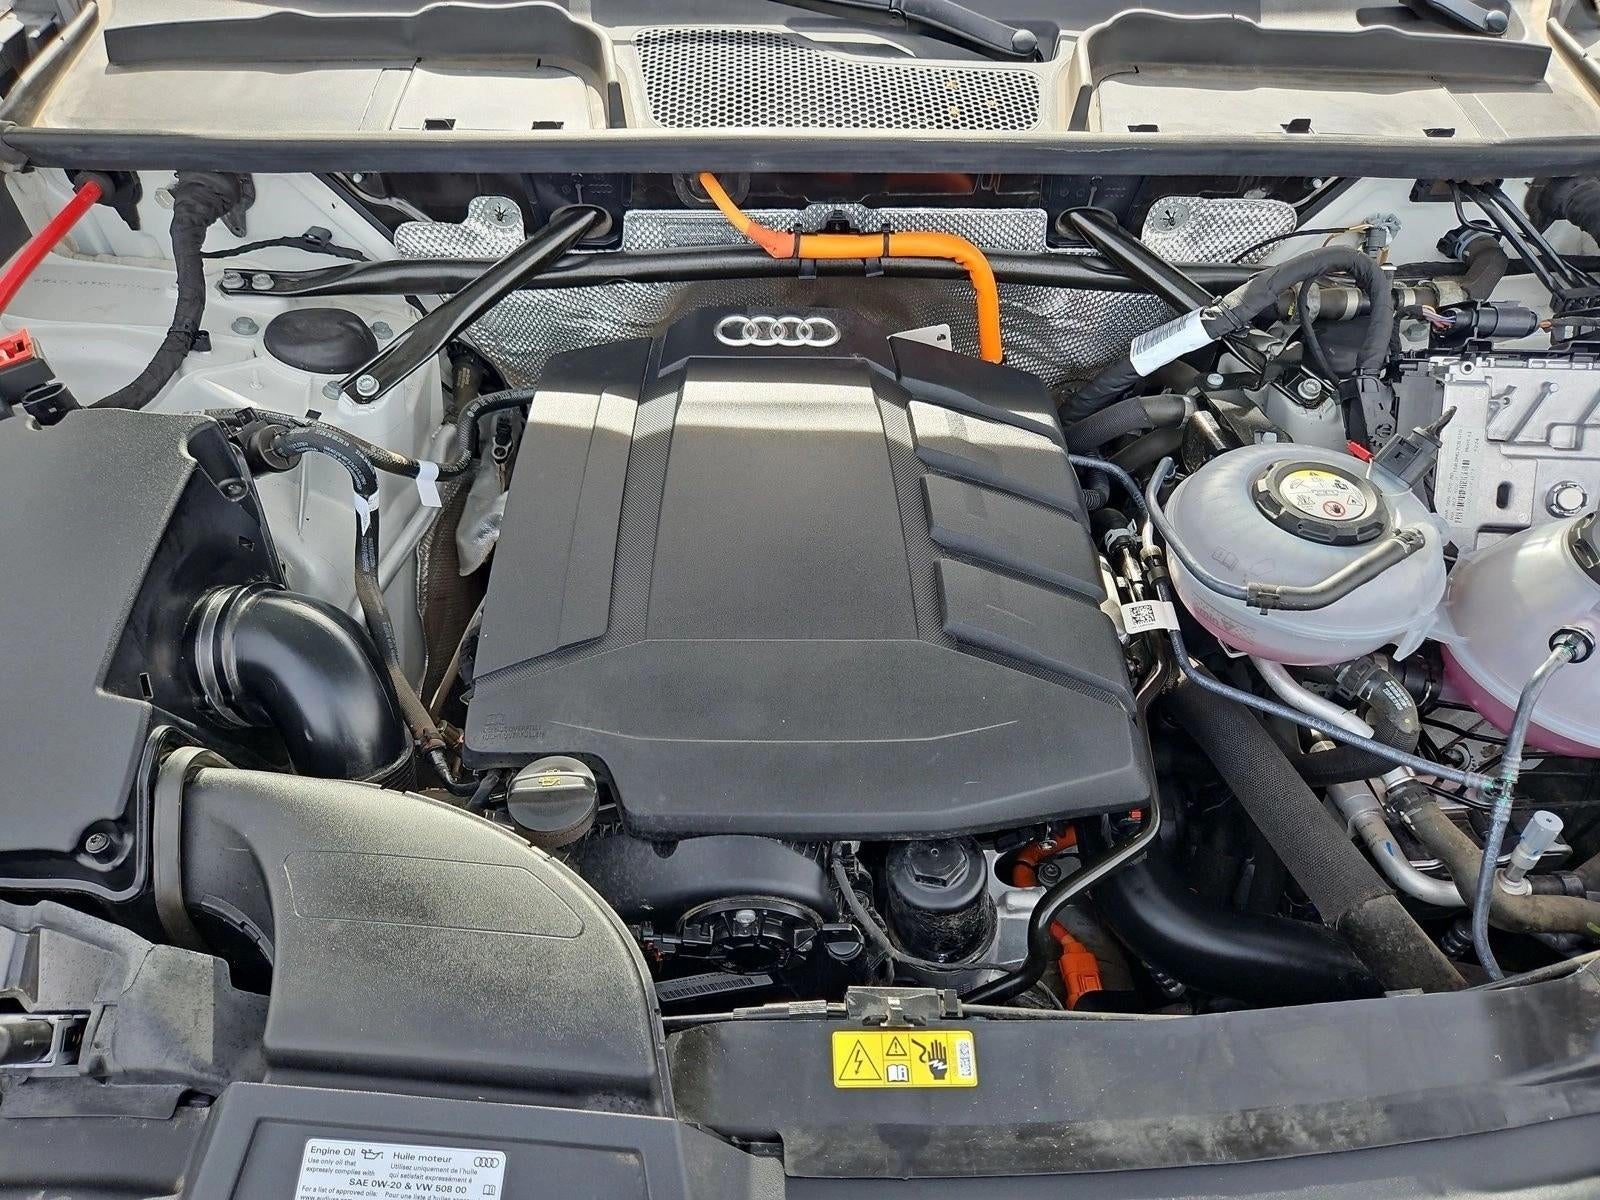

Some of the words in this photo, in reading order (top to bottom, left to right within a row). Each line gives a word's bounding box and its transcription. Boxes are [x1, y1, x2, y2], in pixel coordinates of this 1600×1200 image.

[310, 1146, 340, 1156] Engine
[344, 1148, 356, 1156] Oil
[393, 1152, 416, 1160] Huile
[349, 1178, 369, 1186] SAE
[371, 1180, 402, 1189] 0W-20
[404, 1182, 412, 1190] &
[416, 1183, 433, 1191] VW
[435, 1185, 452, 1193] 508
